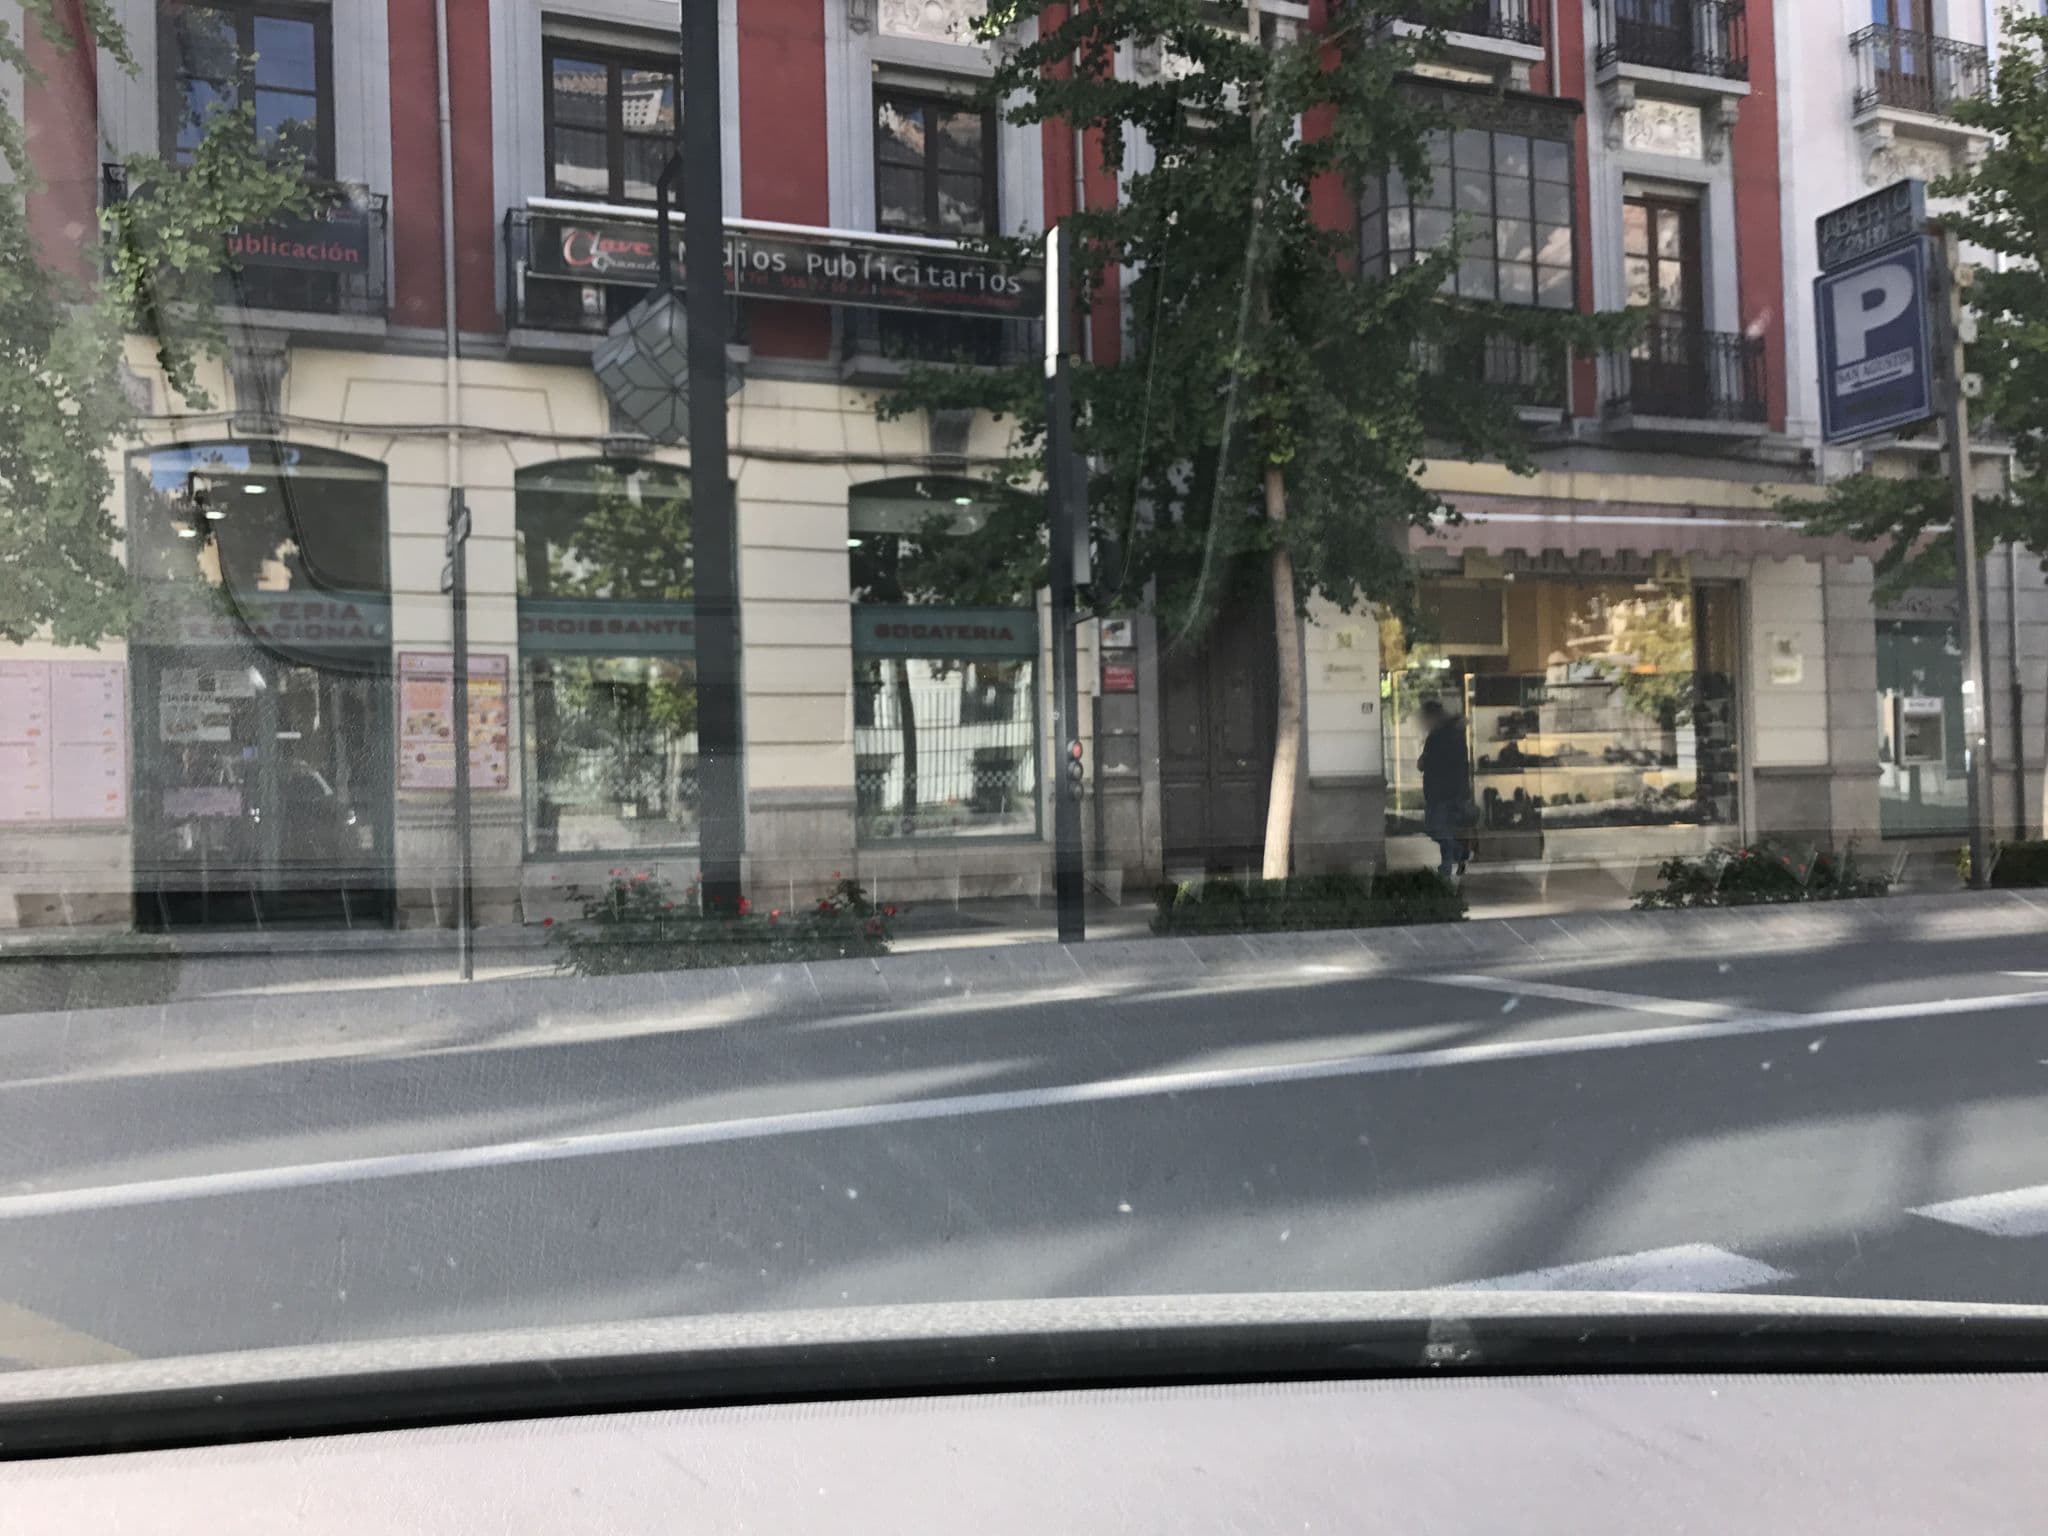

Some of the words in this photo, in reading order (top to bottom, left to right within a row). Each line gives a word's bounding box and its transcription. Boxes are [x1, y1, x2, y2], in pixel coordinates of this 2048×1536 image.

[227, 233, 359, 263] ublicación
[807, 251, 1022, 294] Publicitarios
[1833, 264, 1914, 366] P
[519, 616, 694, 635] CROISSANTE
